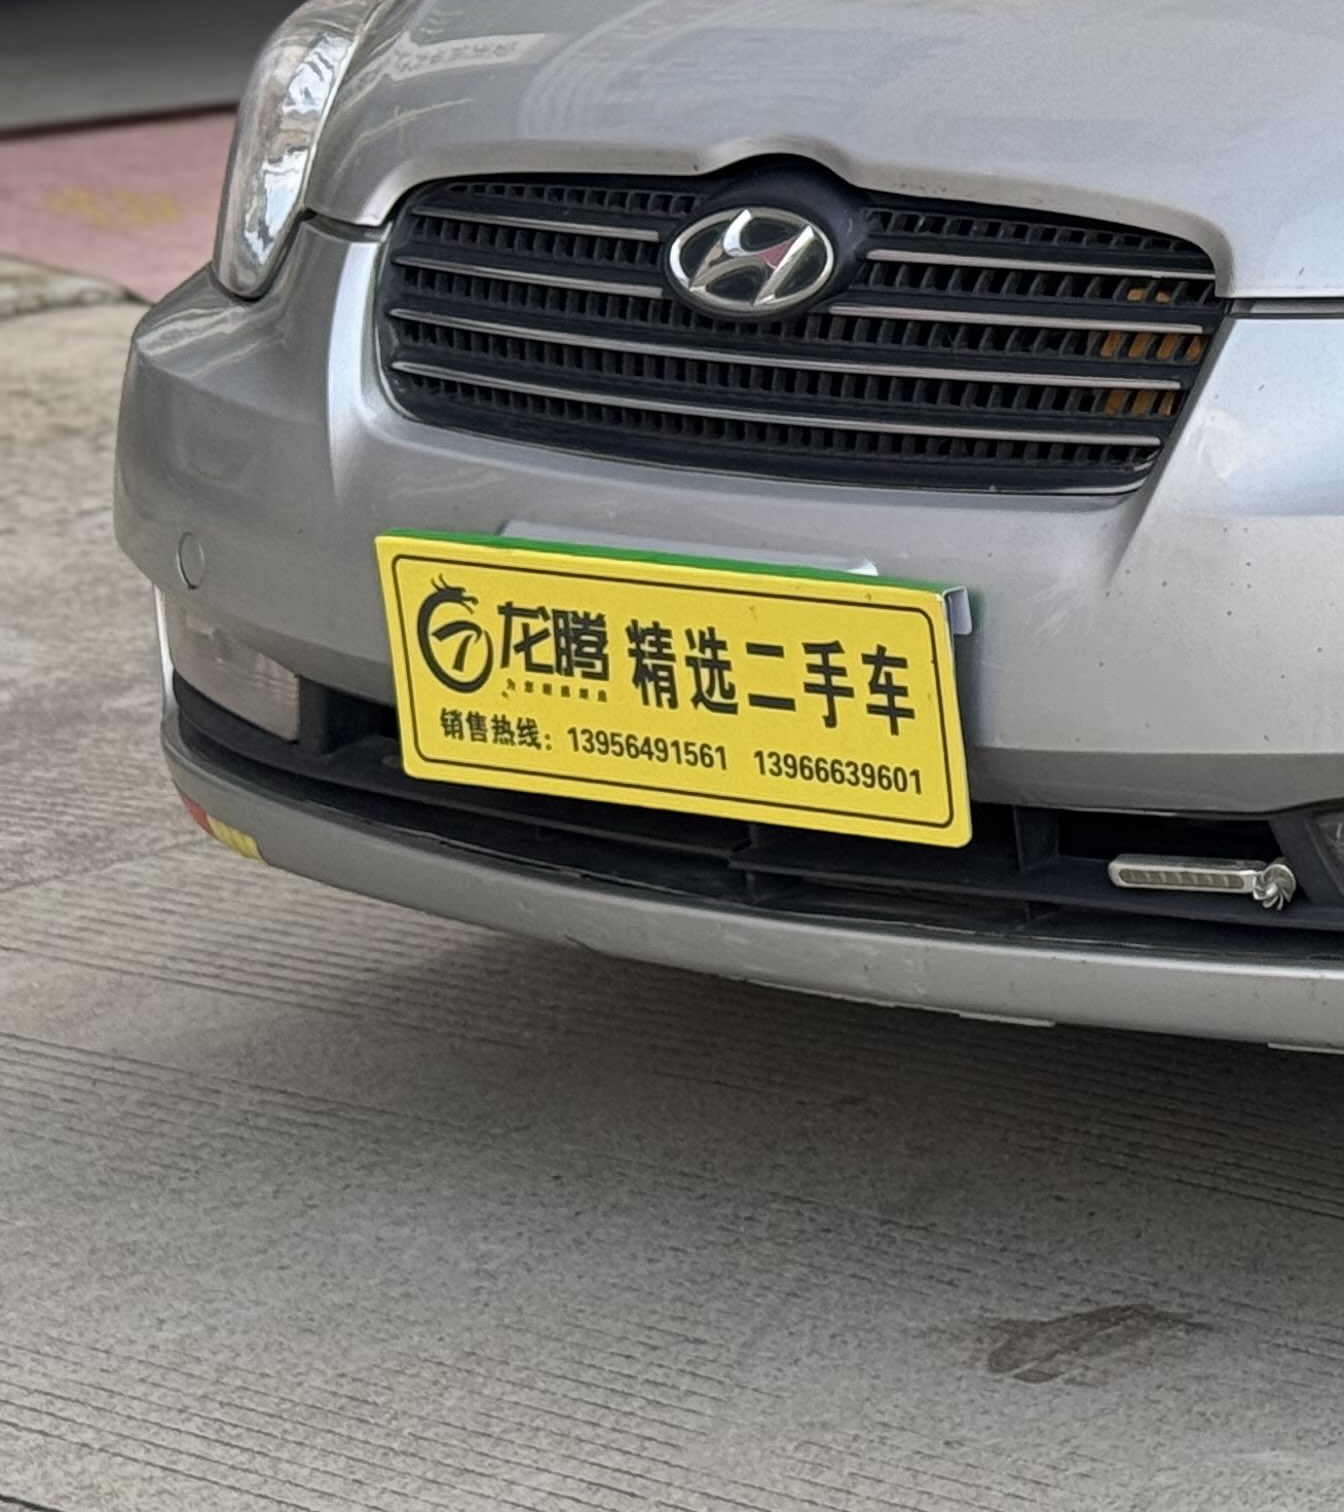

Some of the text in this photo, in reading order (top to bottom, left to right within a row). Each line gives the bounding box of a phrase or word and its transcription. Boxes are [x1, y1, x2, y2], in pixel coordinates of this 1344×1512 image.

[497, 601, 916, 736] 龙腾 精选二手车
[567, 727, 728, 771] 13956491561
[754, 750, 923, 796] 13966639601
